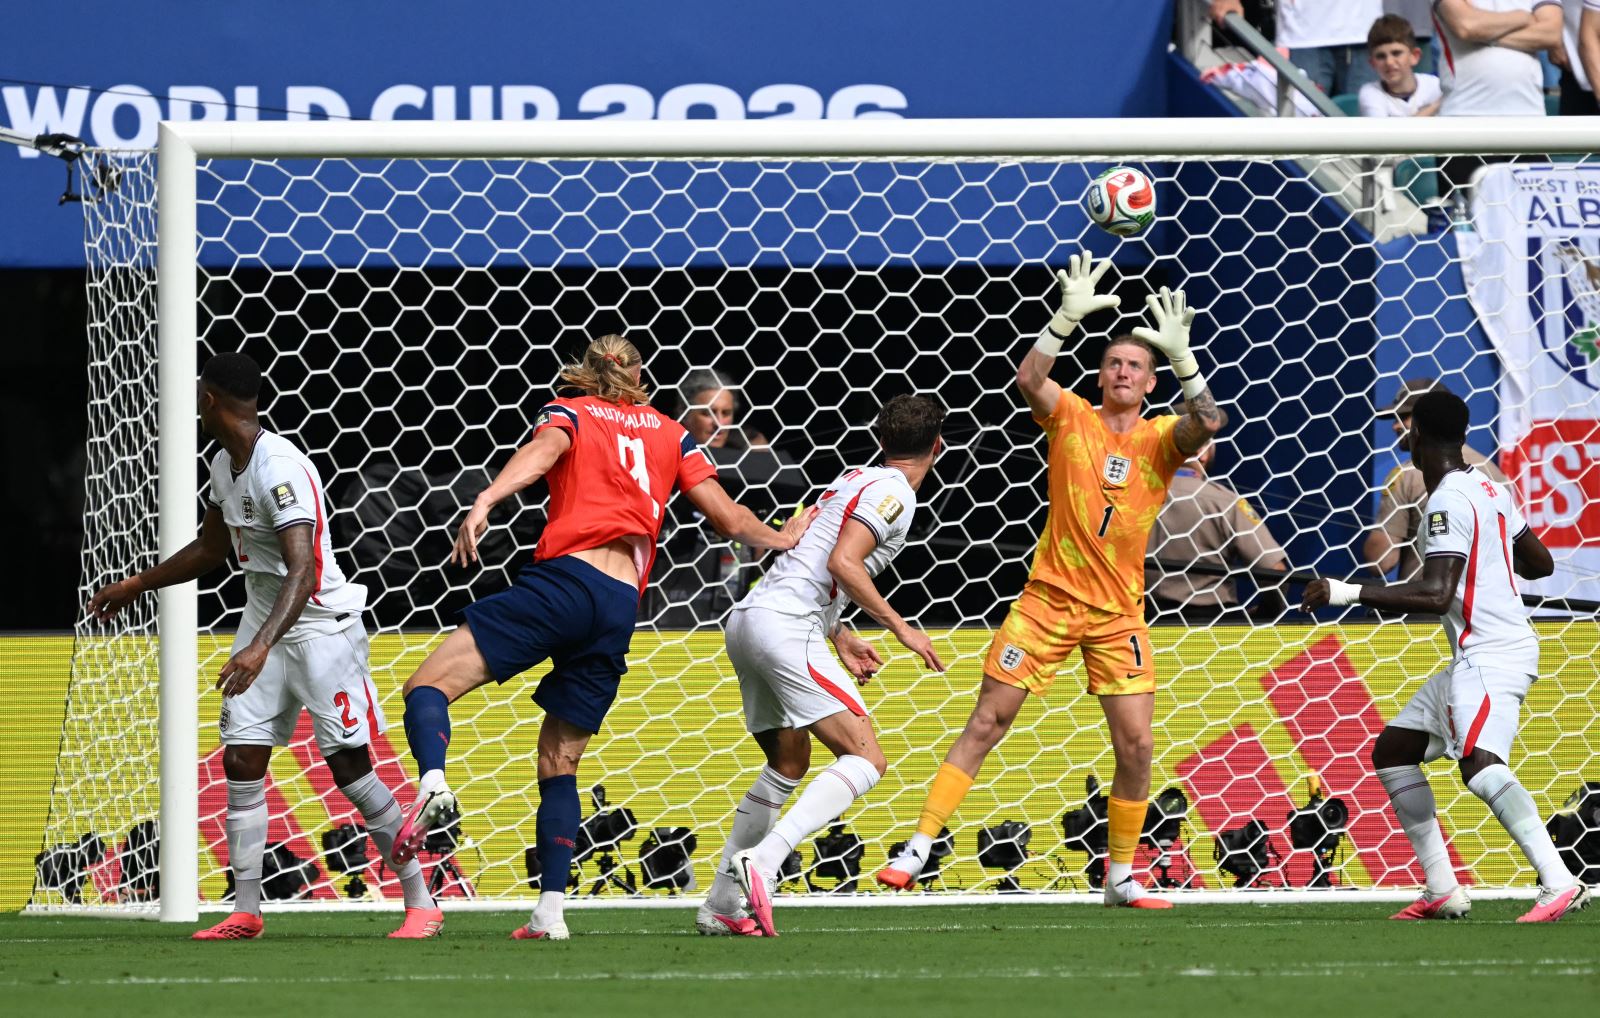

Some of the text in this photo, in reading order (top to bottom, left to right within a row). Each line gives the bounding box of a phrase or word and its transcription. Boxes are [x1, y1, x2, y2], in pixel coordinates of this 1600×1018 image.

[1097, 504, 1115, 538] 1
[1129, 633, 1142, 668] 1
[333, 691, 358, 729] 2
